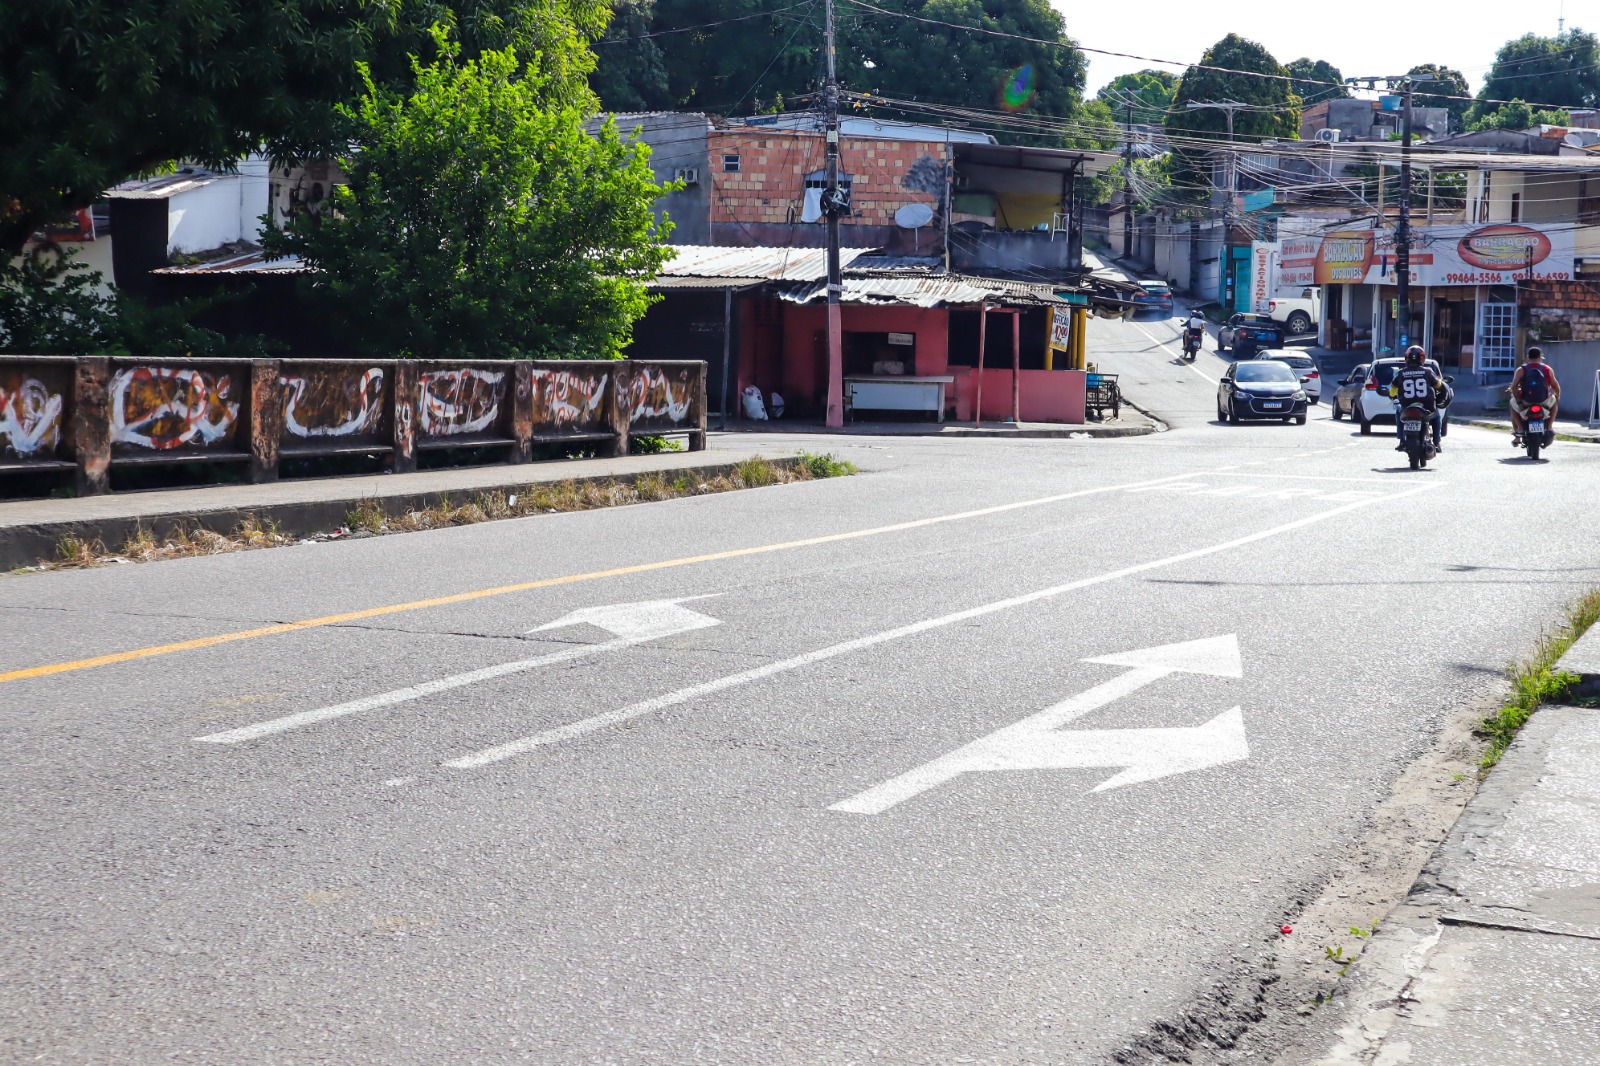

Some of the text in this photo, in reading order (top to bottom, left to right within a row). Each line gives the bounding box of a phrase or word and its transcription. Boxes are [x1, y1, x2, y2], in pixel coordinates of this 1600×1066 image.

[1446, 273, 1501, 283] 99464-5566
[1403, 378, 1428, 399] 99
[1125, 482, 1387, 501] PARE
